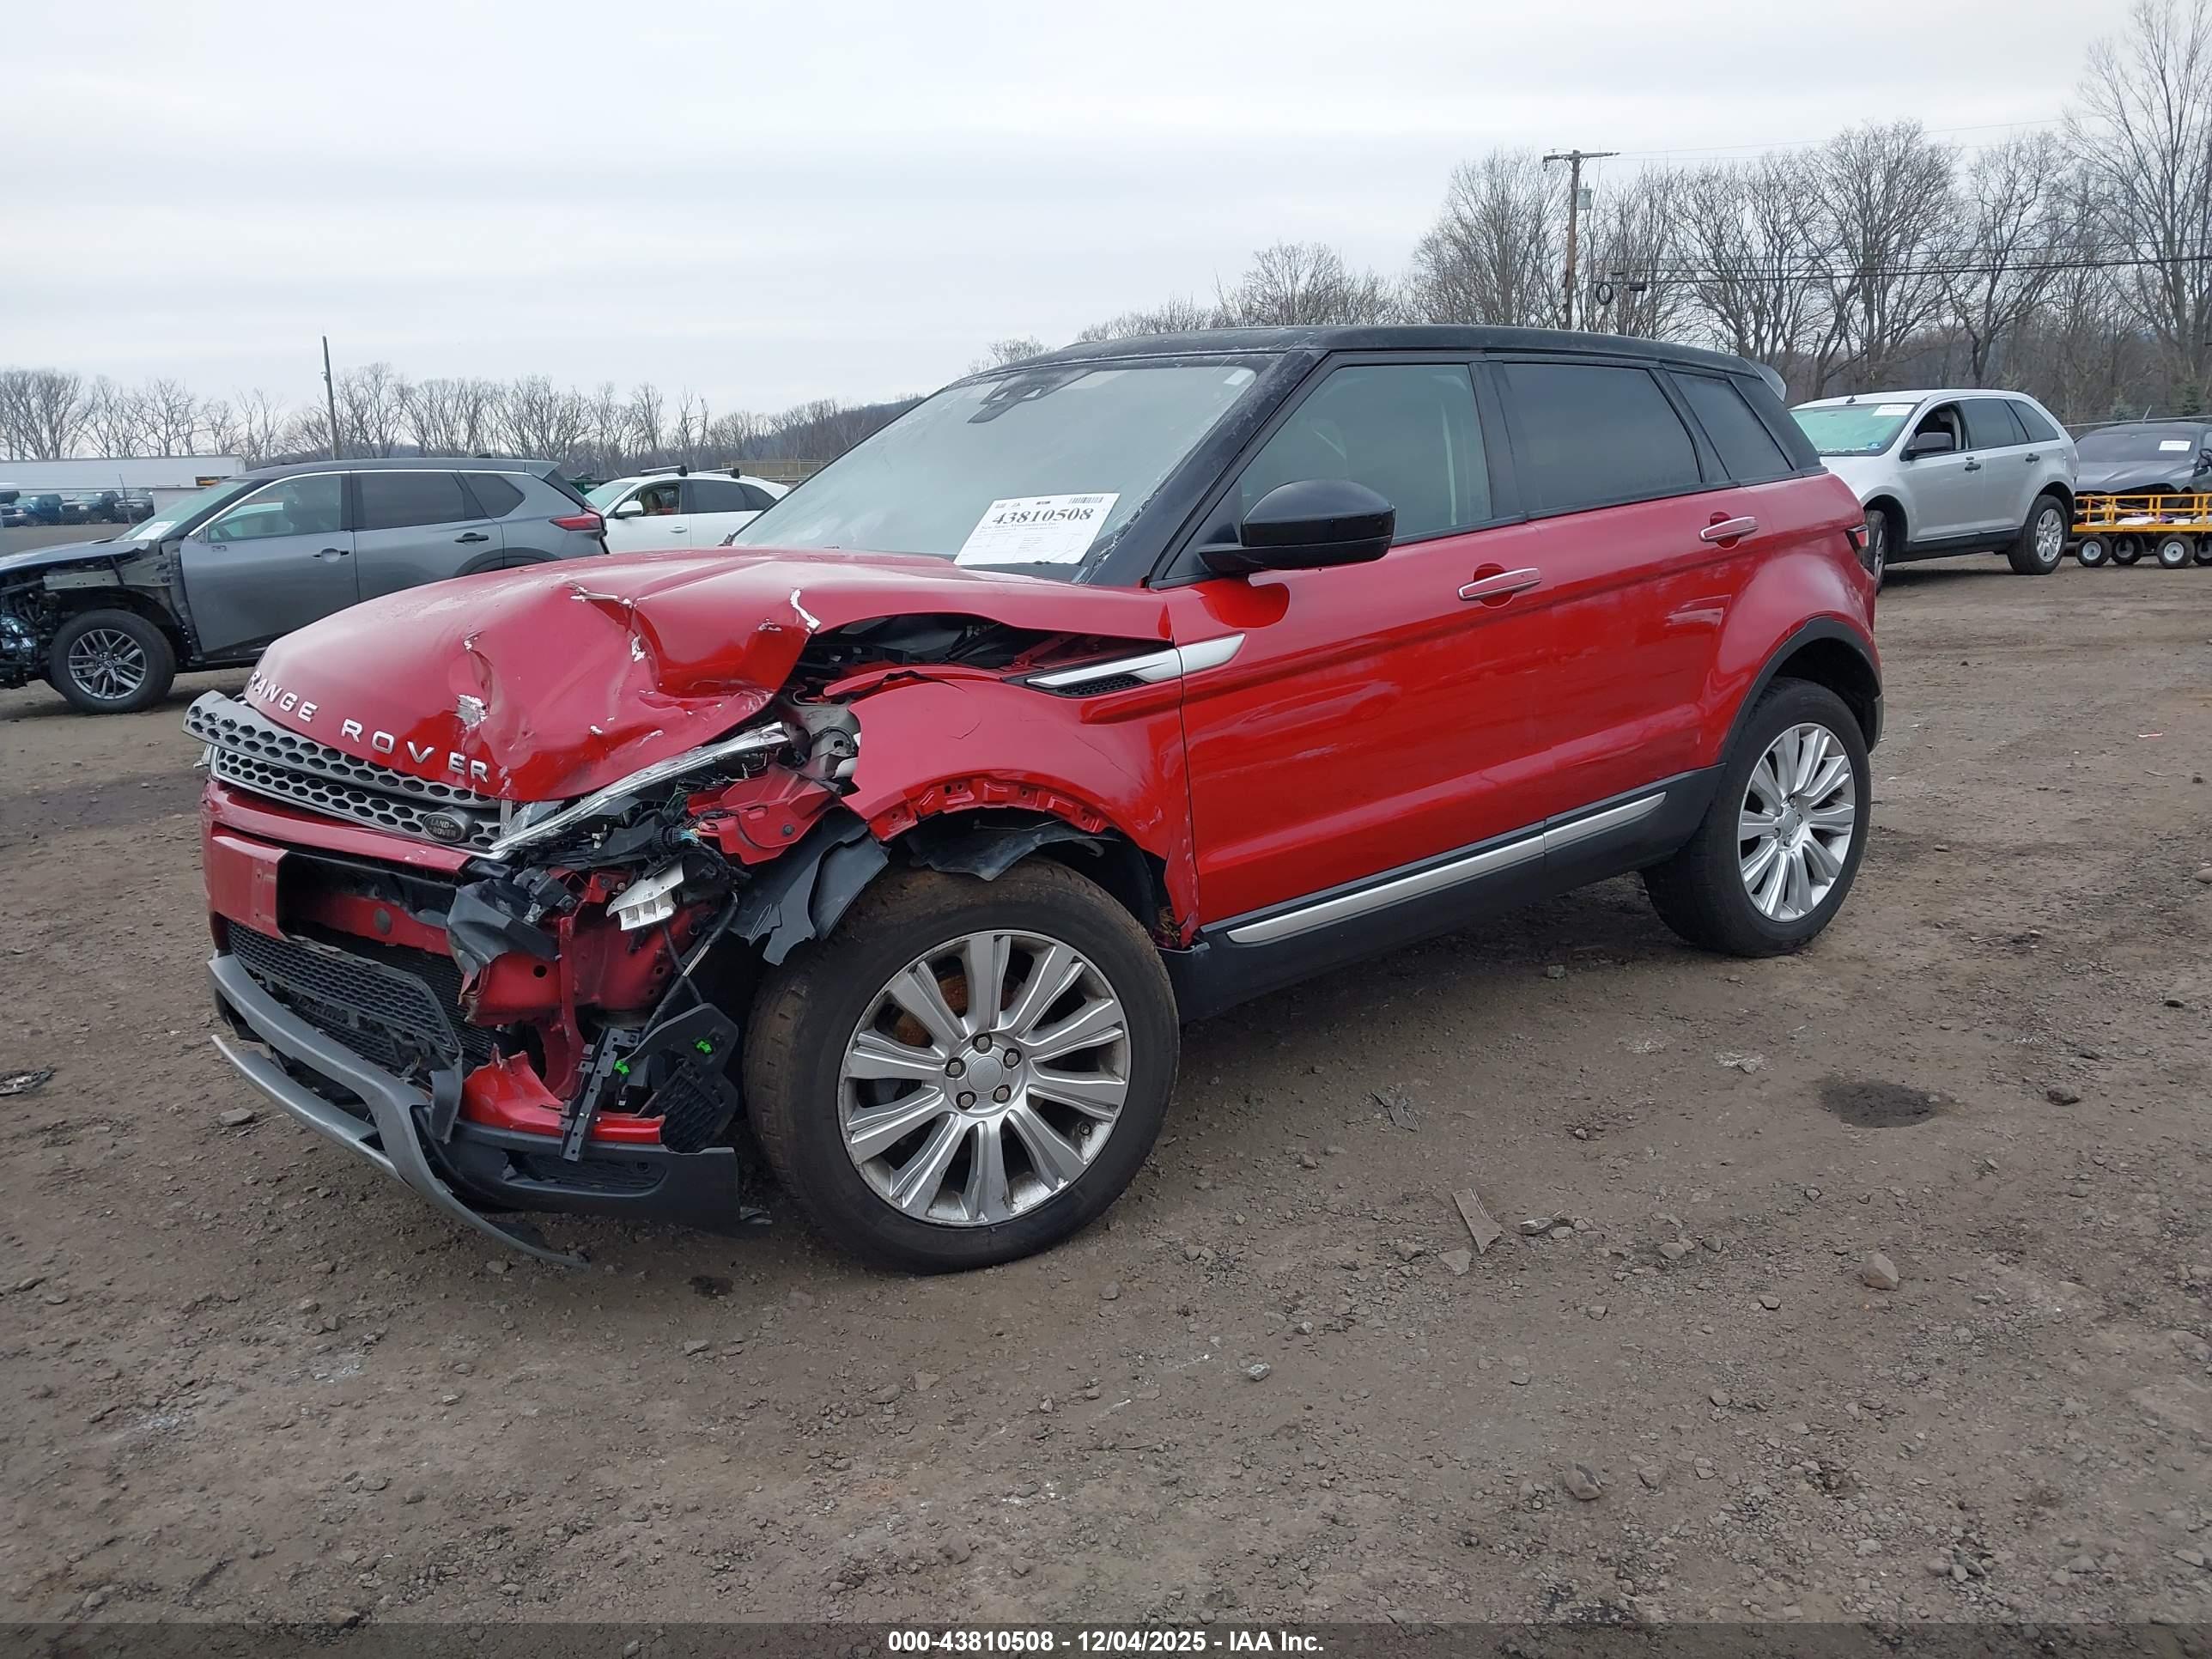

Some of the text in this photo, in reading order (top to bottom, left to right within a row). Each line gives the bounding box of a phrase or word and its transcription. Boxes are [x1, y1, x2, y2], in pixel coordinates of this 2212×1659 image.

[992, 507, 1094, 525] 43810508
[249, 670, 489, 783] RANGE ROVER
